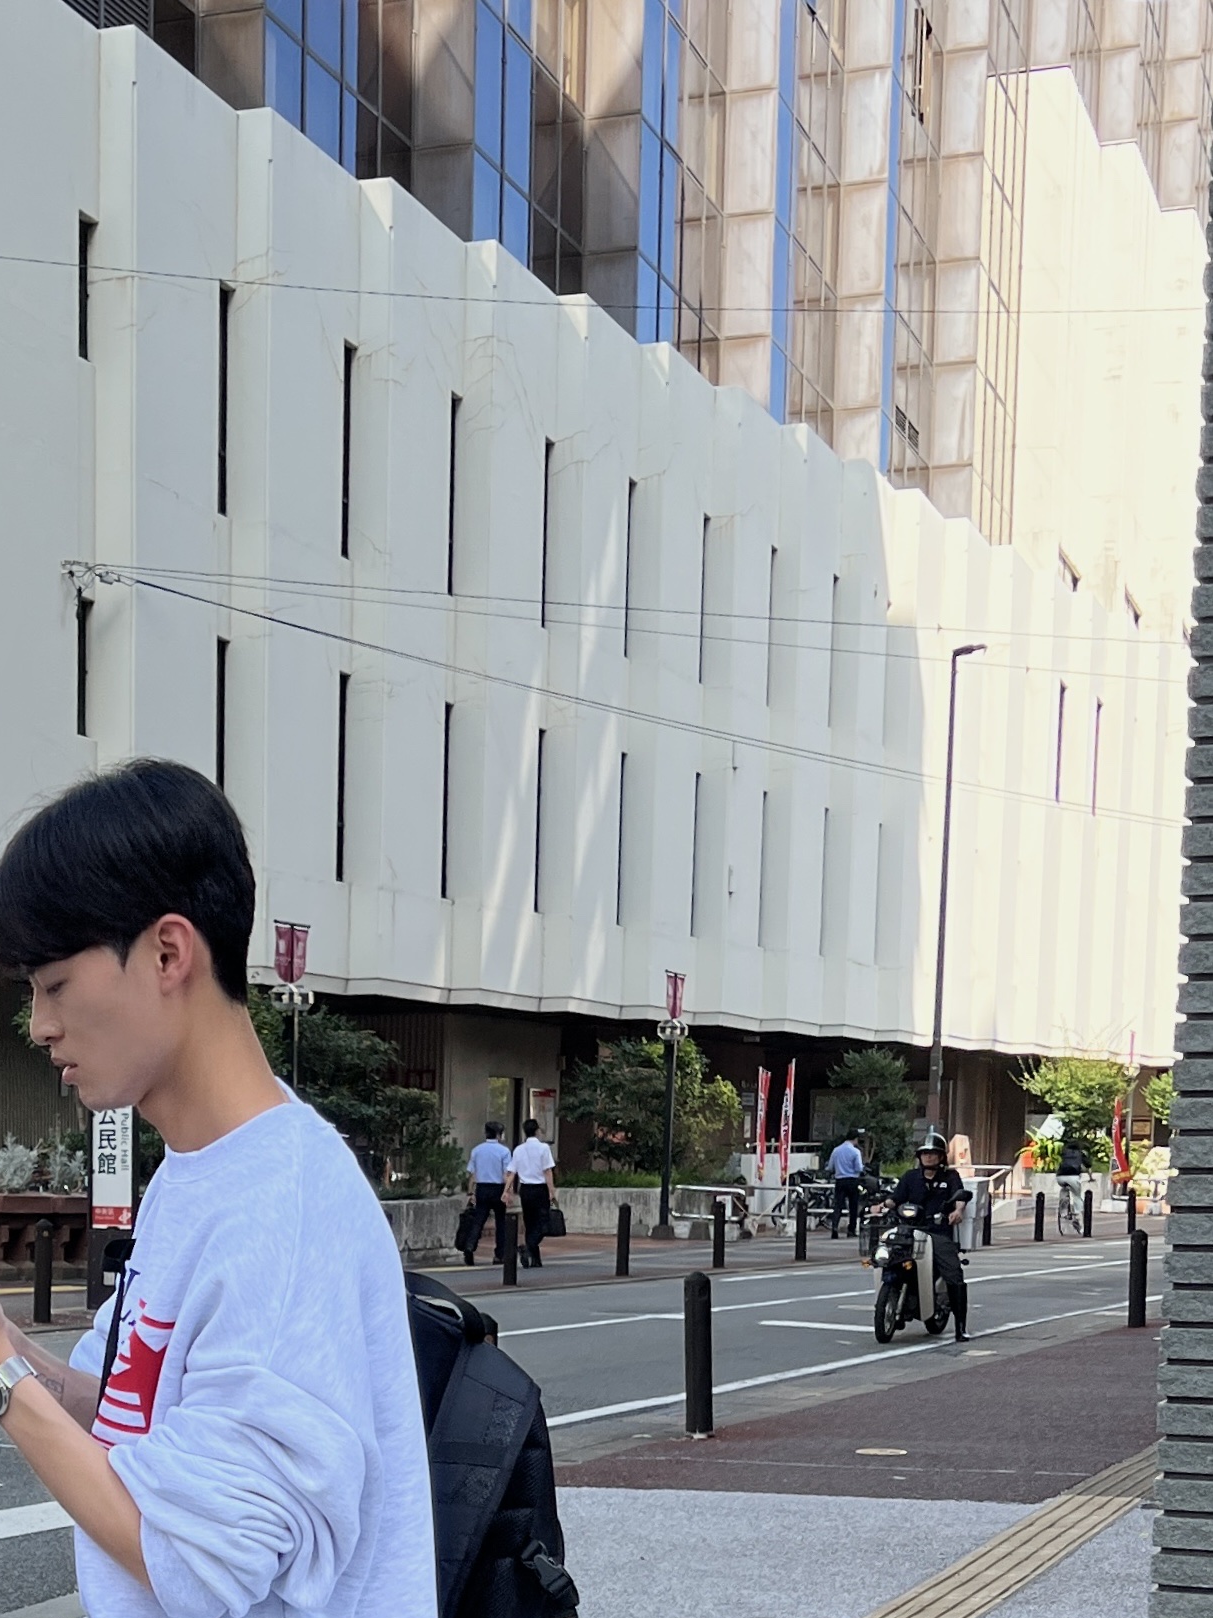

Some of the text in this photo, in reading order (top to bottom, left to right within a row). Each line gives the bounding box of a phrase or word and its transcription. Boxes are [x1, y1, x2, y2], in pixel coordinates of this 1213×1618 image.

[97, 1108, 117, 1175] 公民館
[121, 1112, 130, 1171] Public Hall
